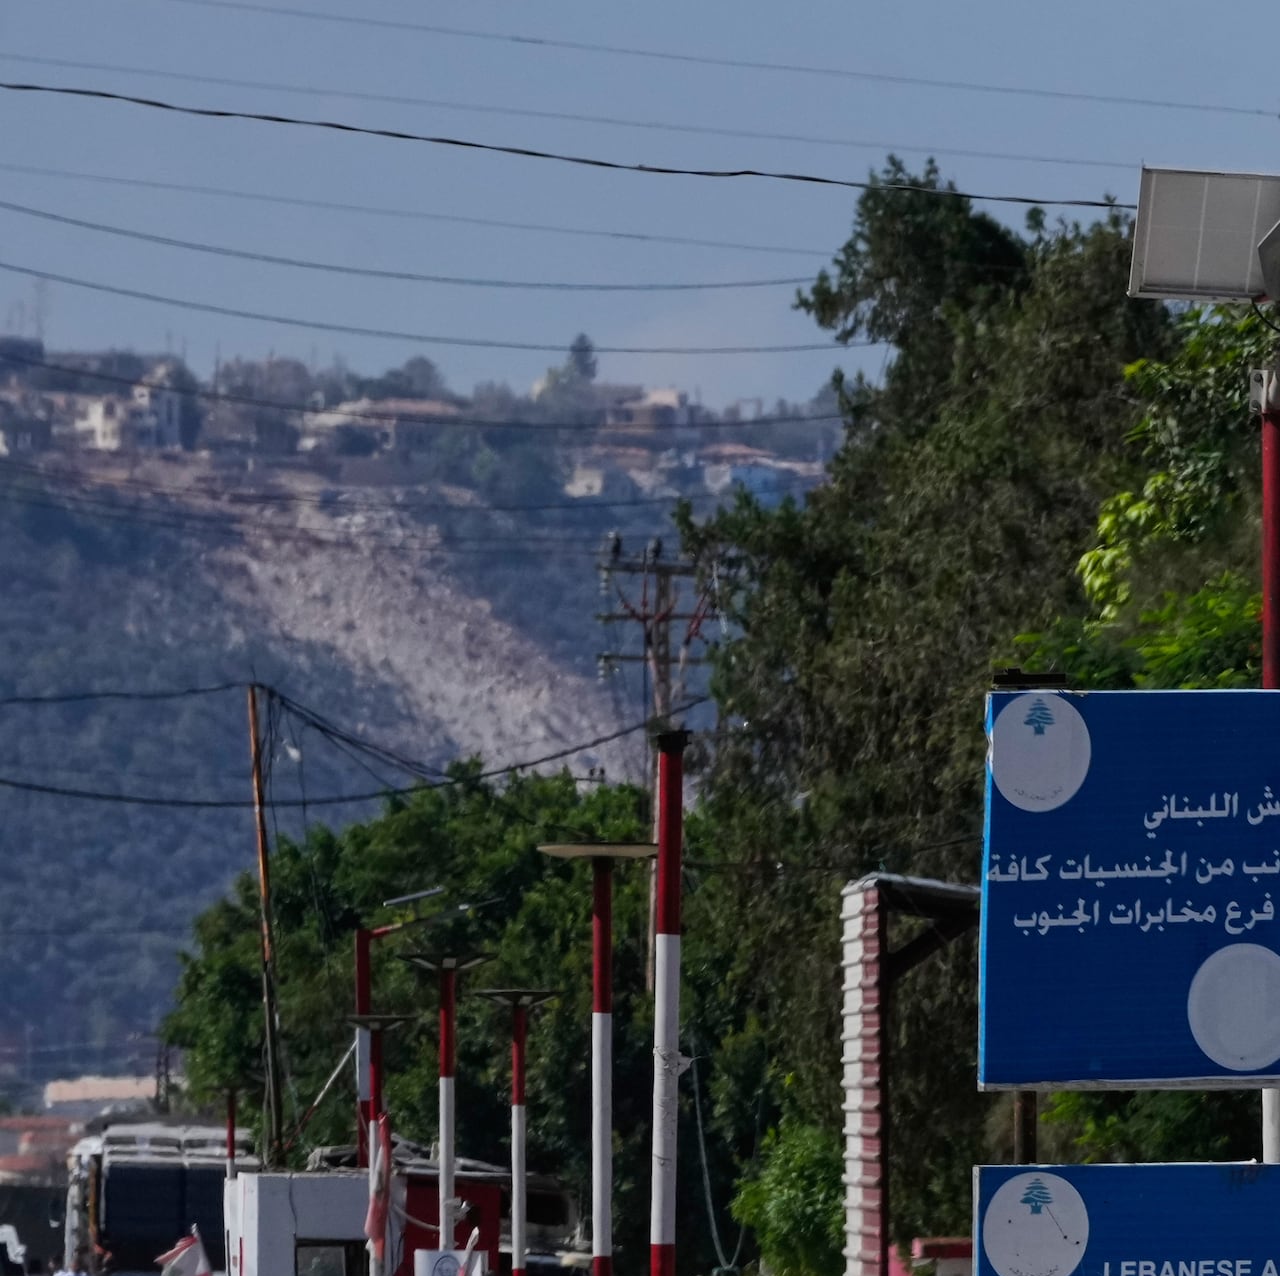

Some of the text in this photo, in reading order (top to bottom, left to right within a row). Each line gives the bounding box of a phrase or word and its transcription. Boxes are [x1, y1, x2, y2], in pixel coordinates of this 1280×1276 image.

[1143, 792, 1239, 839] اللبناني
[987, 854, 1052, 882] كافة
[1059, 850, 1187, 887] الجنسيات
[1196, 858, 1235, 884] من
[1013, 898, 1100, 936] الجنوب
[1109, 899, 1217, 932] مخابرات
[1224, 892, 1275, 935] فرع
